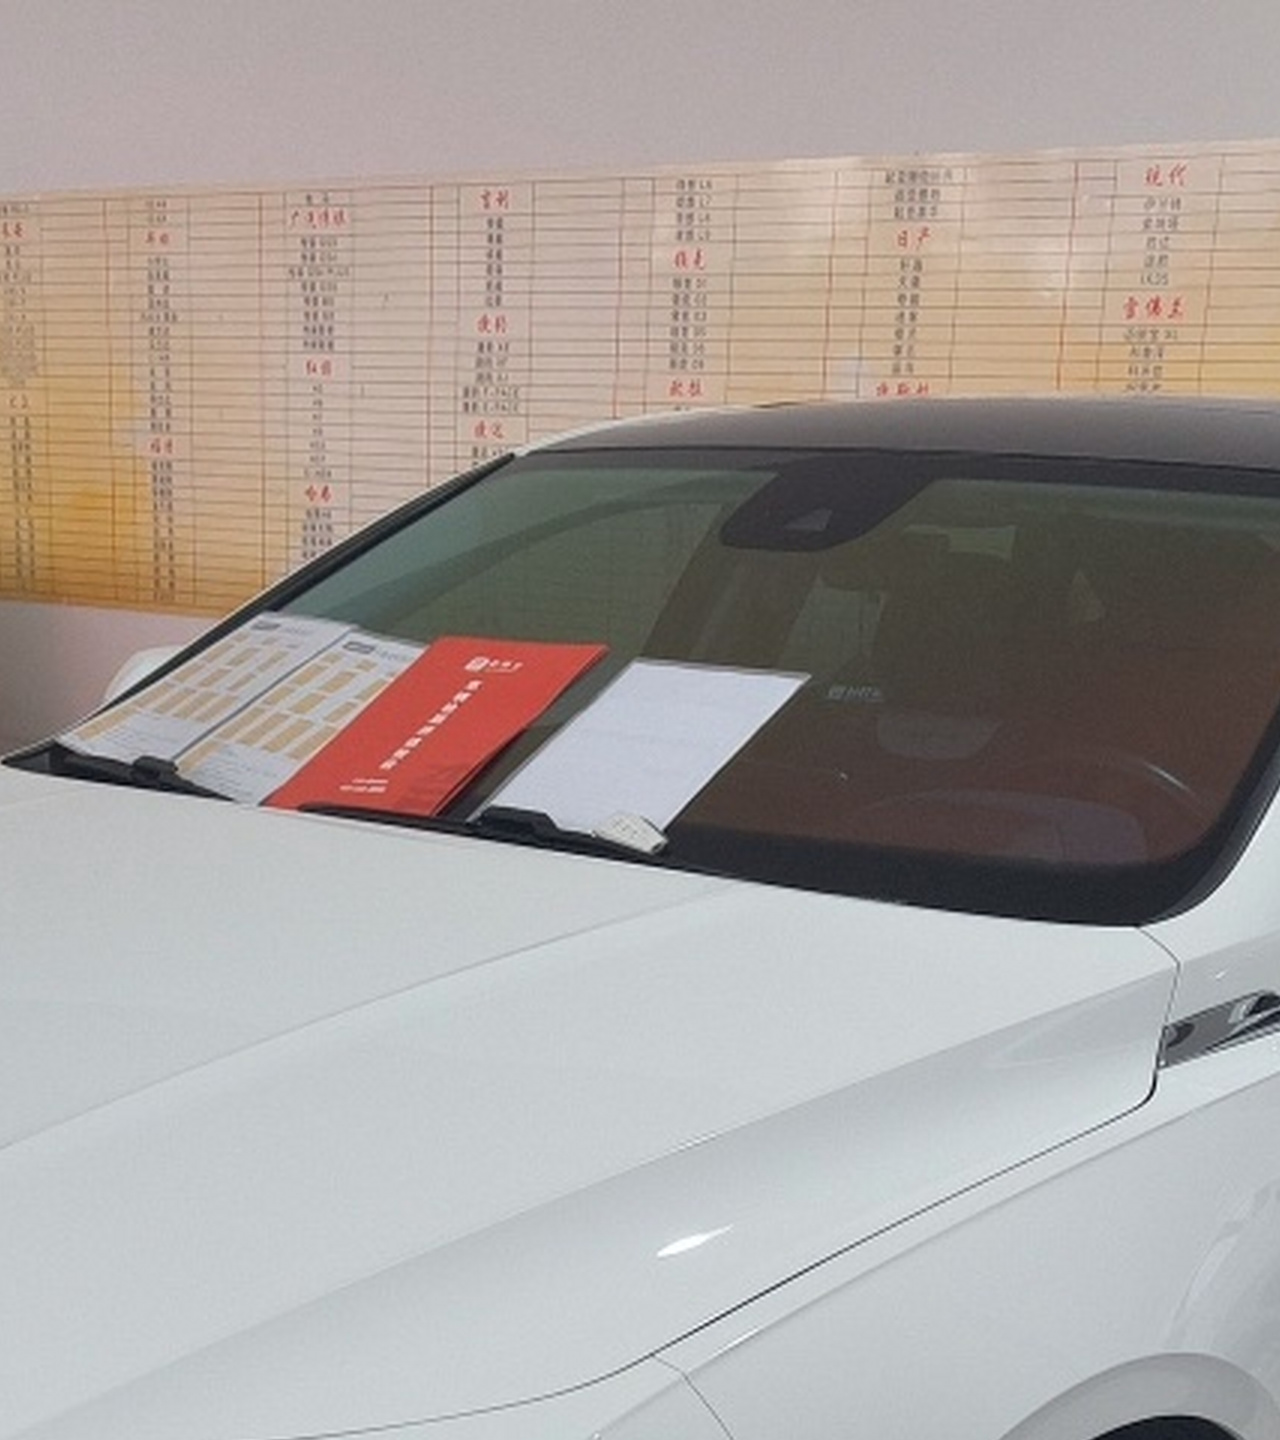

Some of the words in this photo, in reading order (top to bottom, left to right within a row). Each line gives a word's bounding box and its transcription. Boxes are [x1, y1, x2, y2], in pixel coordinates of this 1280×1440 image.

[1143, 162, 1187, 187] 现代
[480, 188, 509, 210] 吉利
[897, 226, 931, 250] 日产
